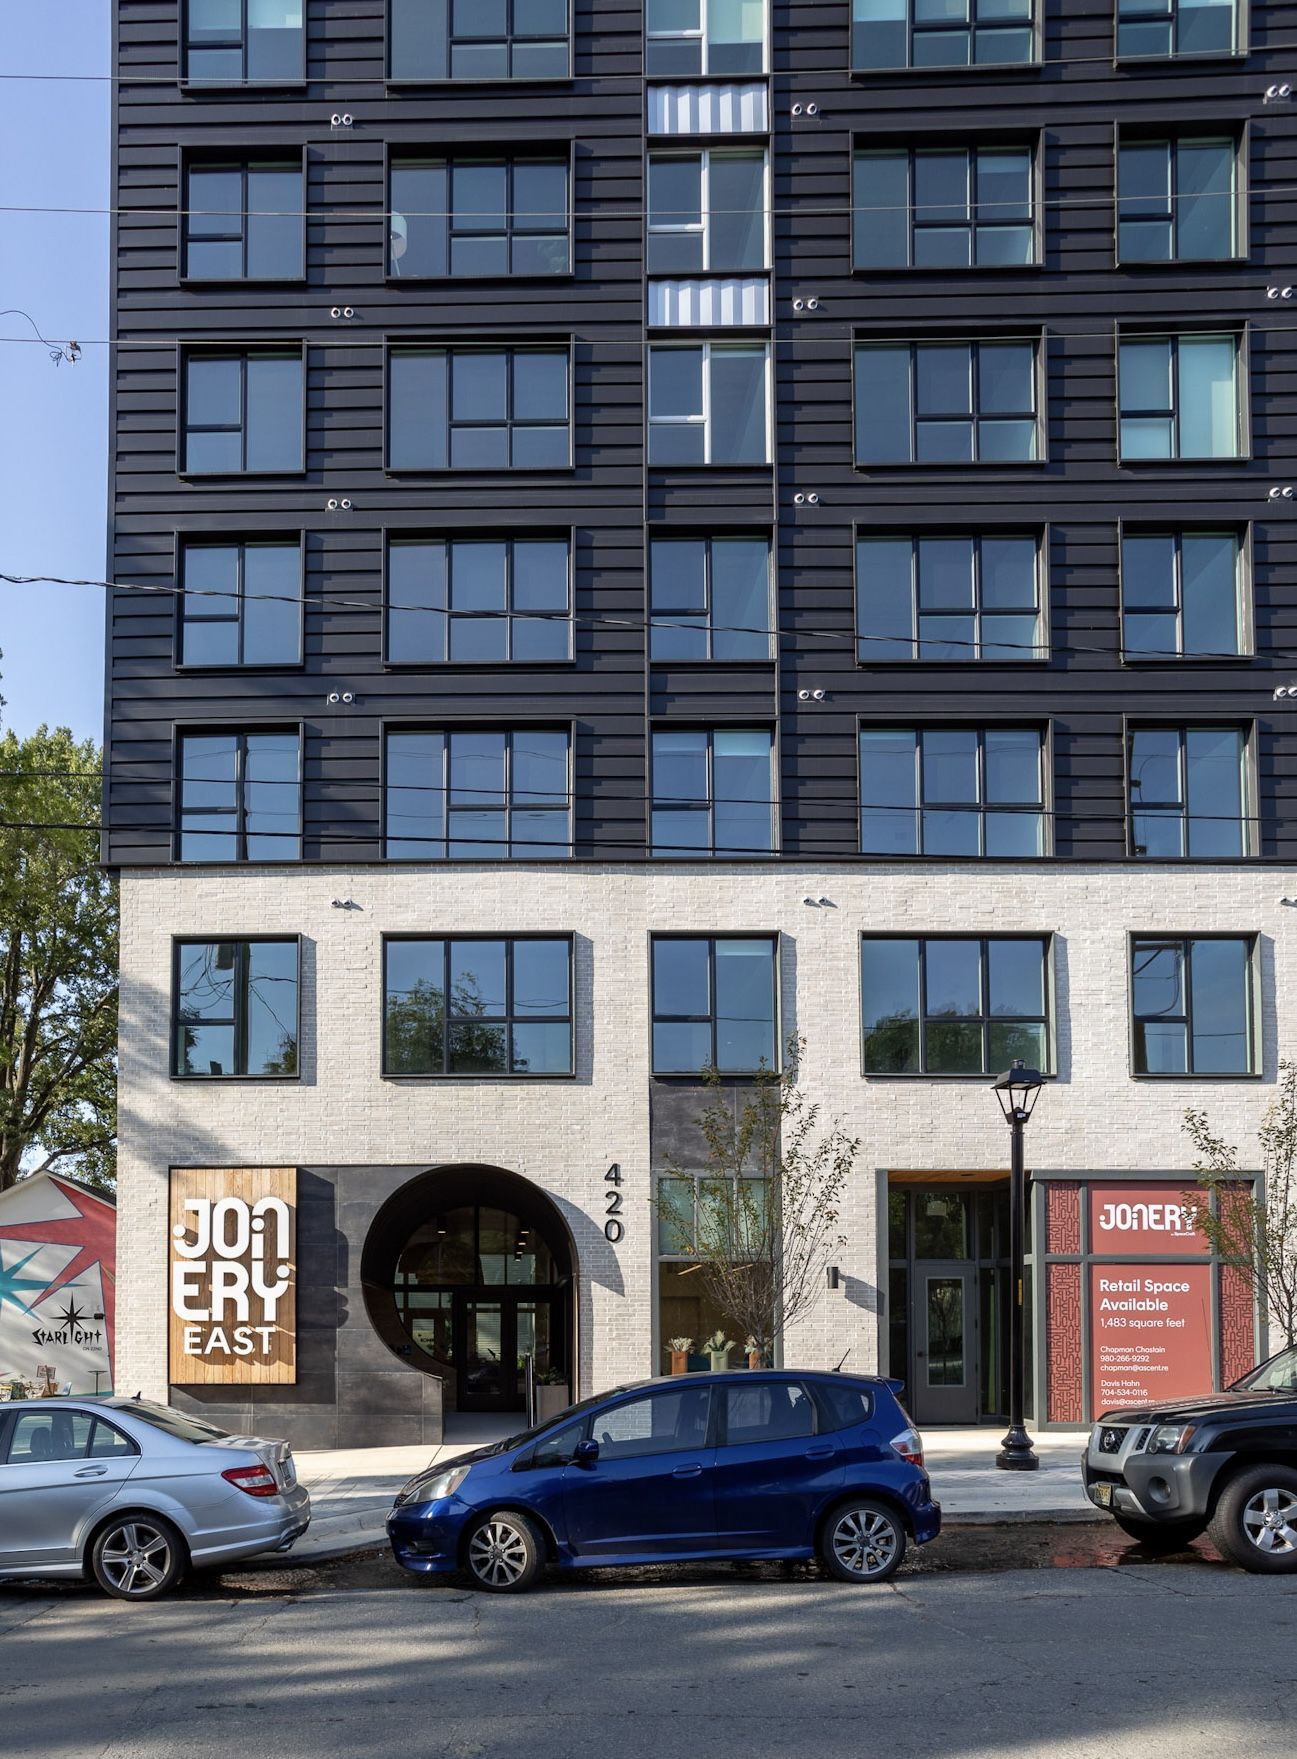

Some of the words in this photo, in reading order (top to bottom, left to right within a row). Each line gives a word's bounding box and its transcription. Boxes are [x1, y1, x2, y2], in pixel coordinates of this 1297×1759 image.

[604, 1163, 623, 1243] 420
[173, 1261, 290, 1322] ERY
[1100, 1279, 1141, 1292] Retail
[1144, 1279, 1190, 1295] Space
[1100, 1298, 1169, 1311] Available
[1100, 1318, 1127, 1329] 1,483
[1129, 1319, 1164, 1329] square
[1166, 1317, 1185, 1328] feet
[183, 1326, 277, 1355] EAST
[1100, 1346, 1135, 1354] Chapman
